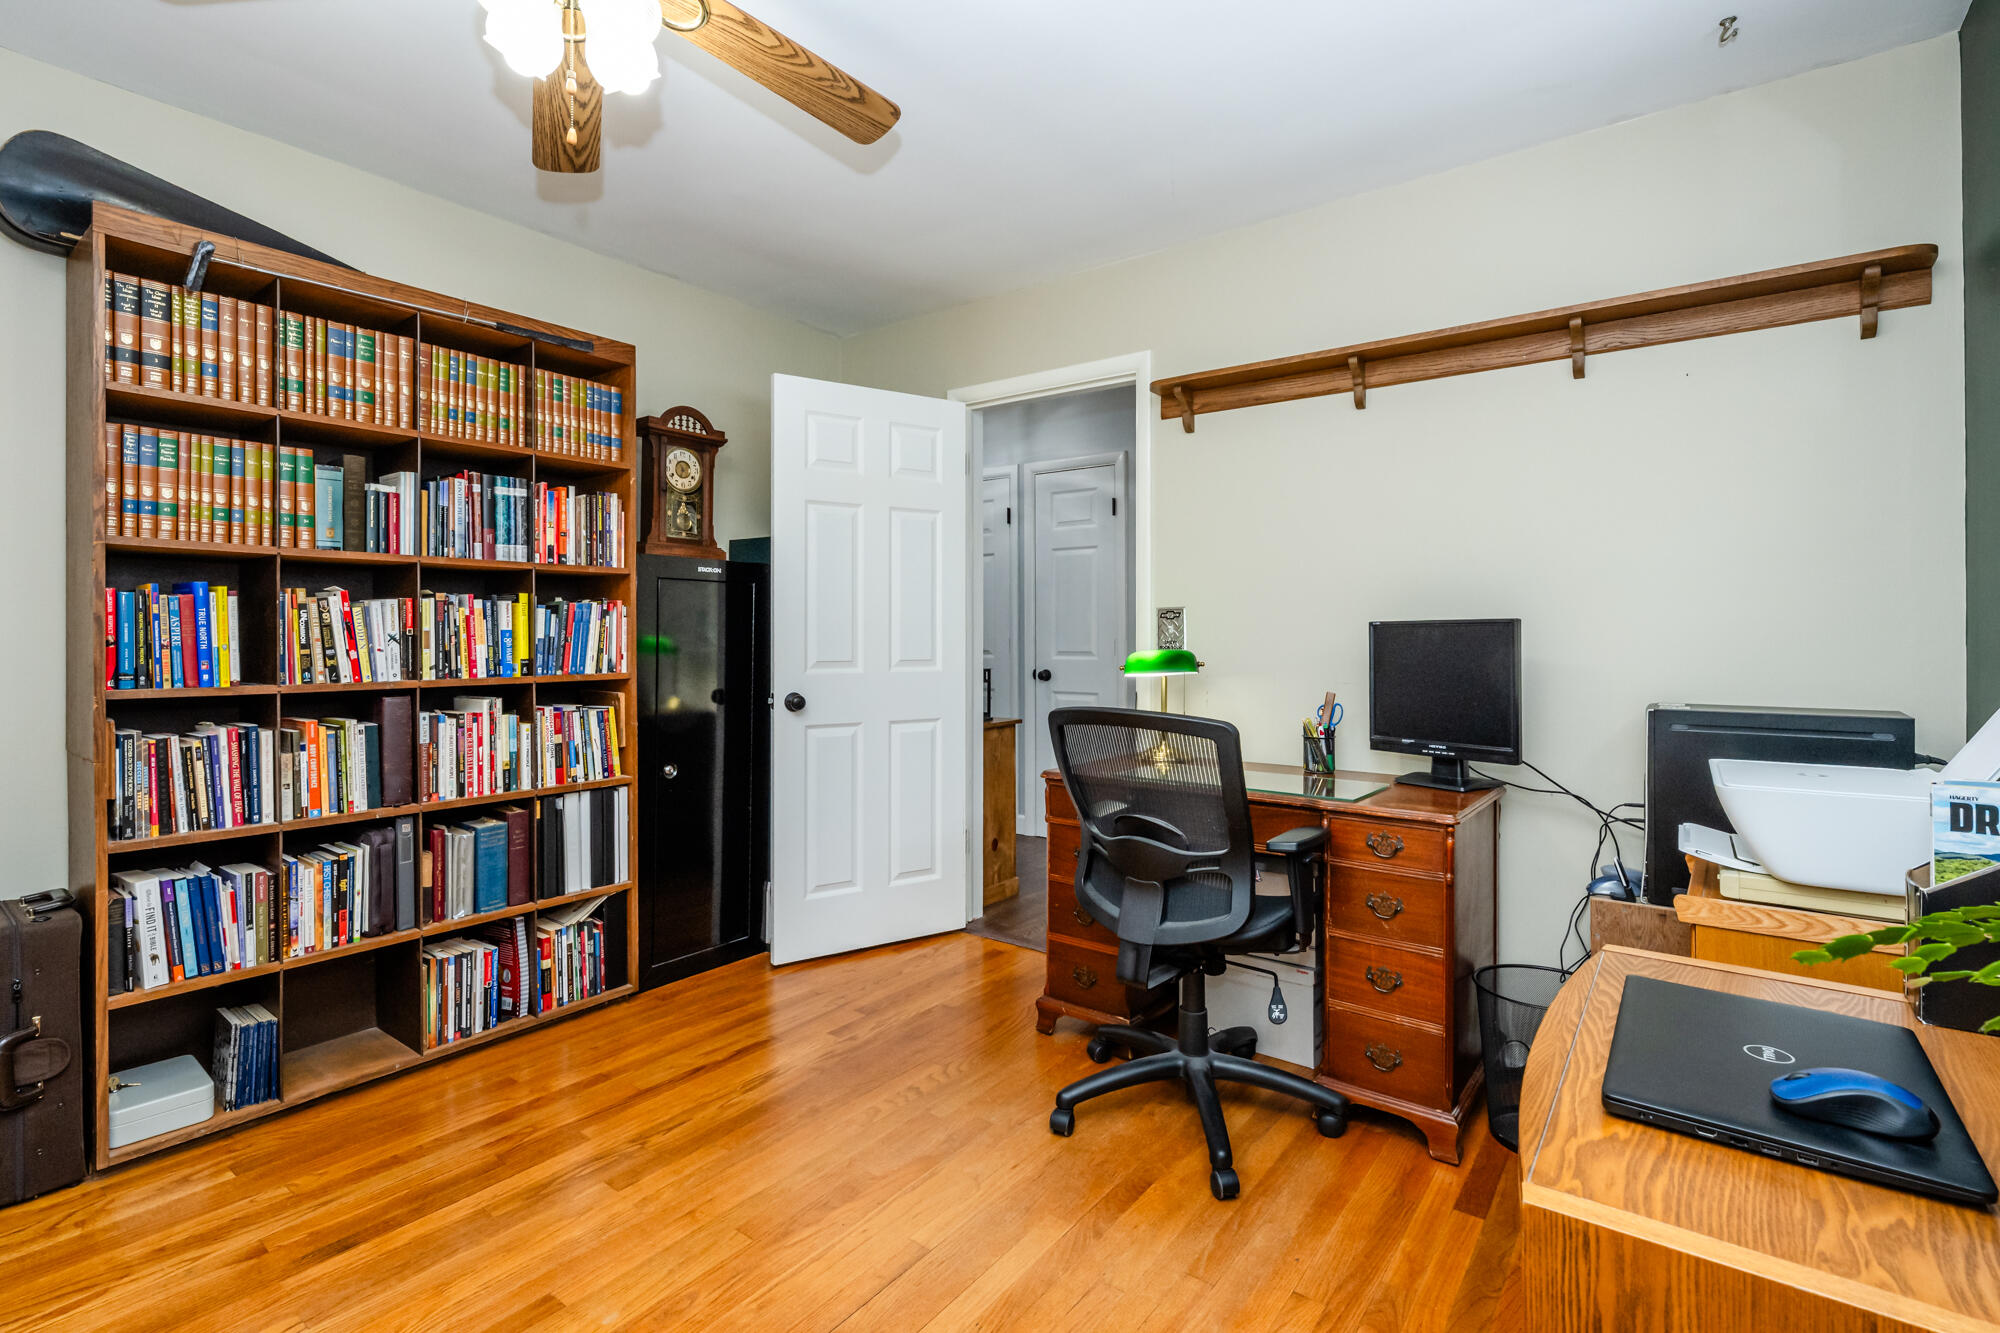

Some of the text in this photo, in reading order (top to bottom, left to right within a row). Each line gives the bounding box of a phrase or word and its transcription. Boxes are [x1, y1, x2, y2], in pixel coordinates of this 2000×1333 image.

[170, 615, 181, 647] ASPIRE
[198, 608, 208, 649] TRUE NORTH
[299, 609, 308, 644] UNCOMMON
[354, 609, 367, 650] WOODEN
[231, 741, 239, 768] SMASHING
[233, 778, 241, 792] WALL
[309, 758, 317, 788] CONFIDENCE
[145, 906, 156, 925] FIND
[146, 925, 157, 933] IT
[149, 936, 157, 951] BIBLE
[1762, 1046, 1777, 1061] DELL
